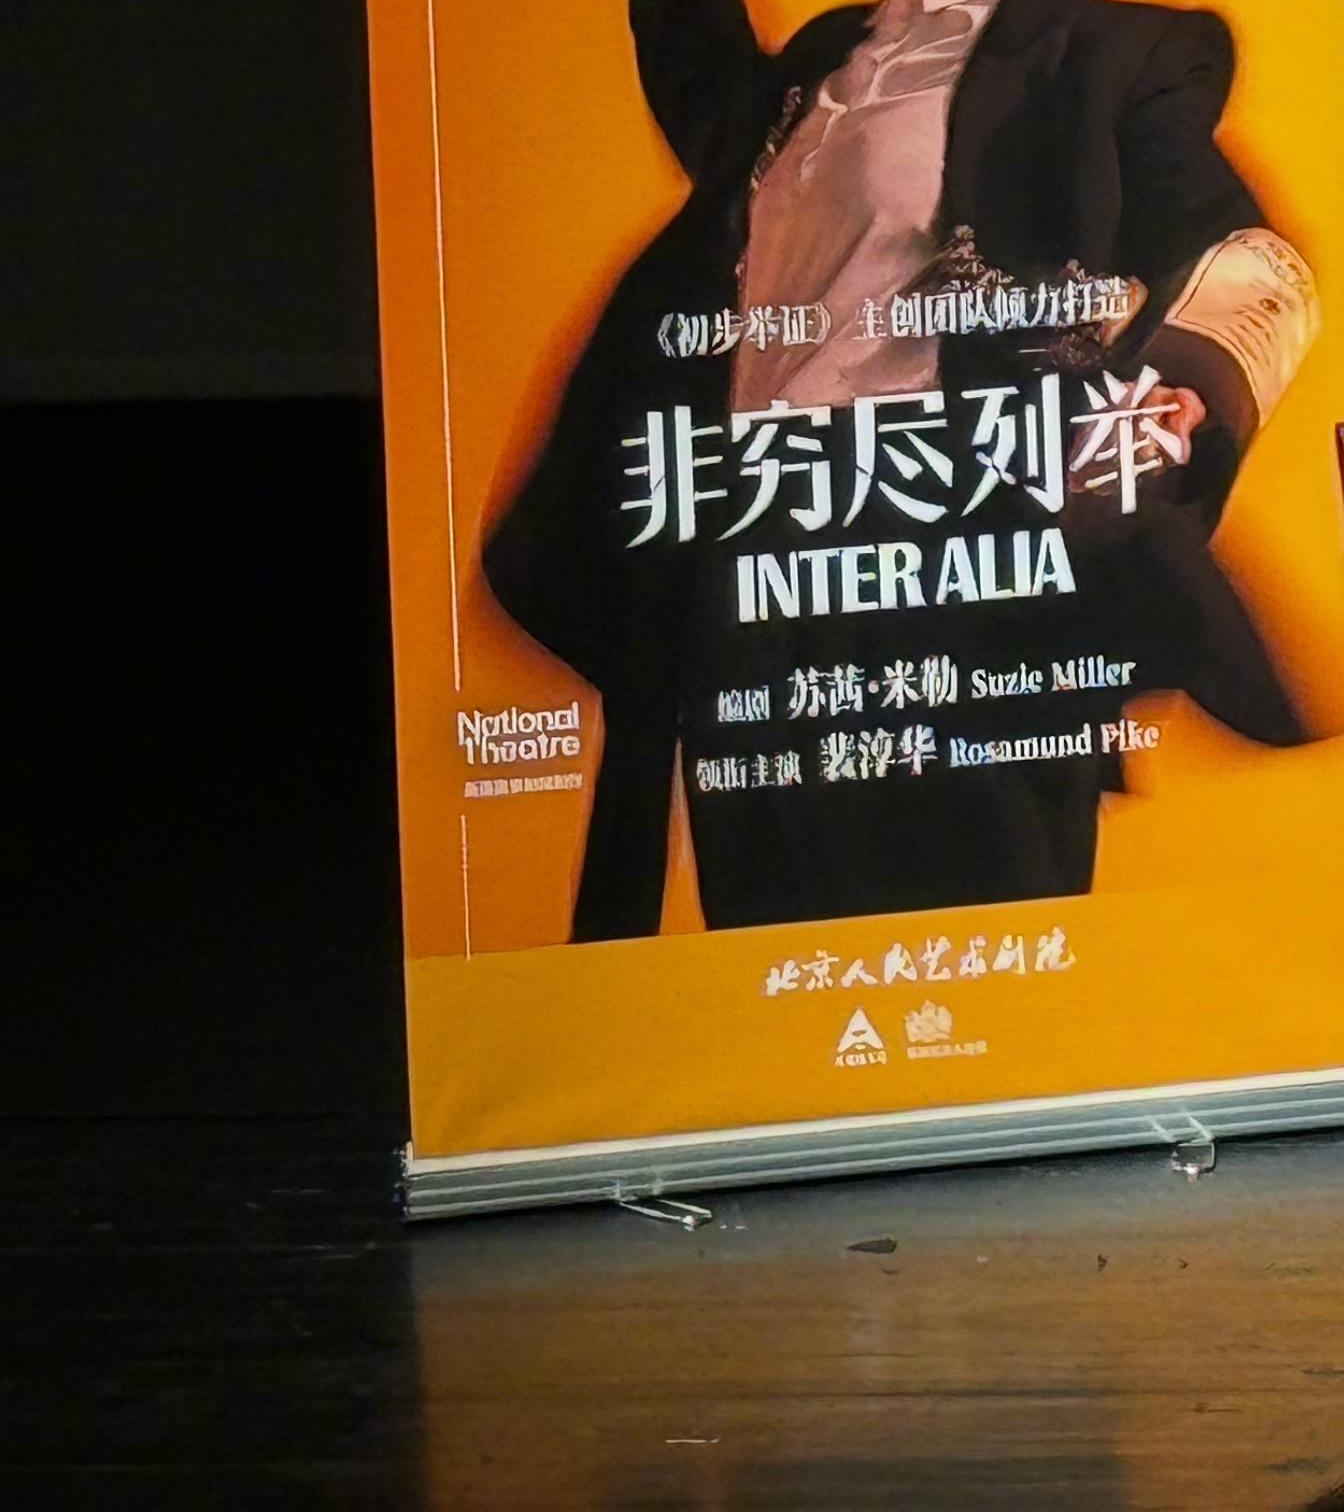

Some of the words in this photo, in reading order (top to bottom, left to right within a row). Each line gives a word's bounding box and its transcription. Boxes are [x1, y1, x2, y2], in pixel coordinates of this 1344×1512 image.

[619, 364, 1186, 548] 非穷尽列举
[737, 541, 926, 623] INTER
[936, 527, 1077, 605] ALIA
[971, 662, 1044, 700] Suzie
[1051, 654, 1137, 692] Miller
[457, 701, 580, 747] National
[463, 733, 581, 765] Theatre
[950, 722, 1094, 768] Rosamund
[1100, 718, 1161, 754] Pike
[766, 926, 1077, 996] 北京人民艺术剧院
